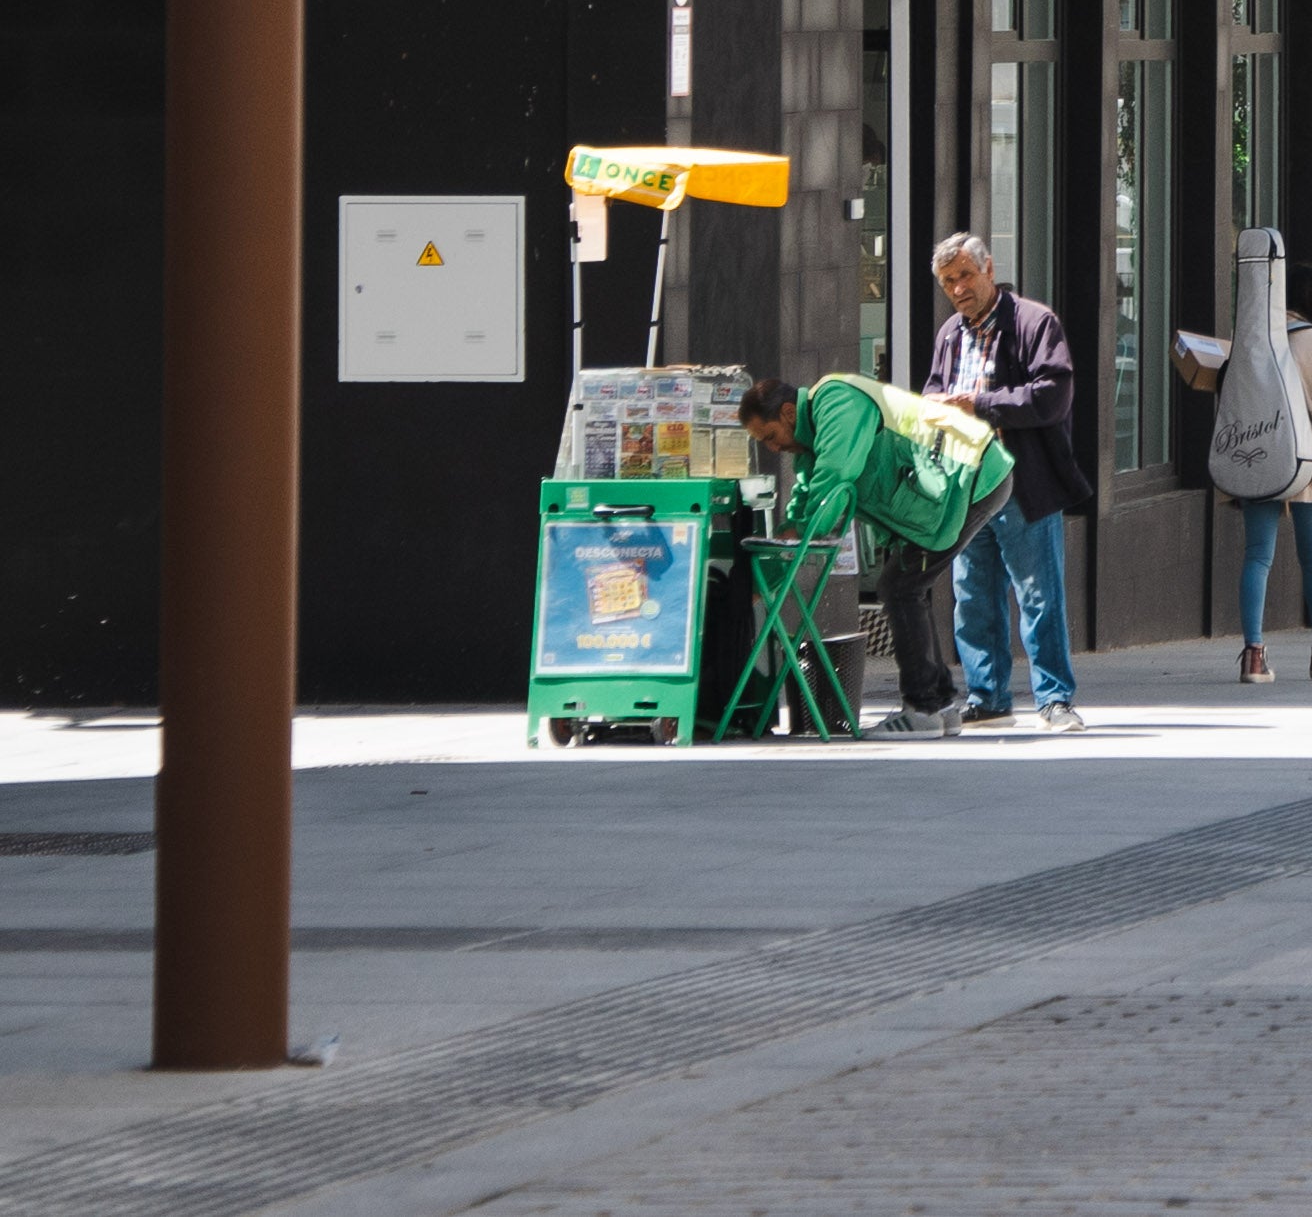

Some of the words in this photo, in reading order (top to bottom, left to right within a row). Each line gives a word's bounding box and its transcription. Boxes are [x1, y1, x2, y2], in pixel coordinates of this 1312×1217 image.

[605, 162, 674, 192] ONCE
[1214, 410, 1281, 455] Bristol
[575, 545, 664, 560] DESCONECTA
